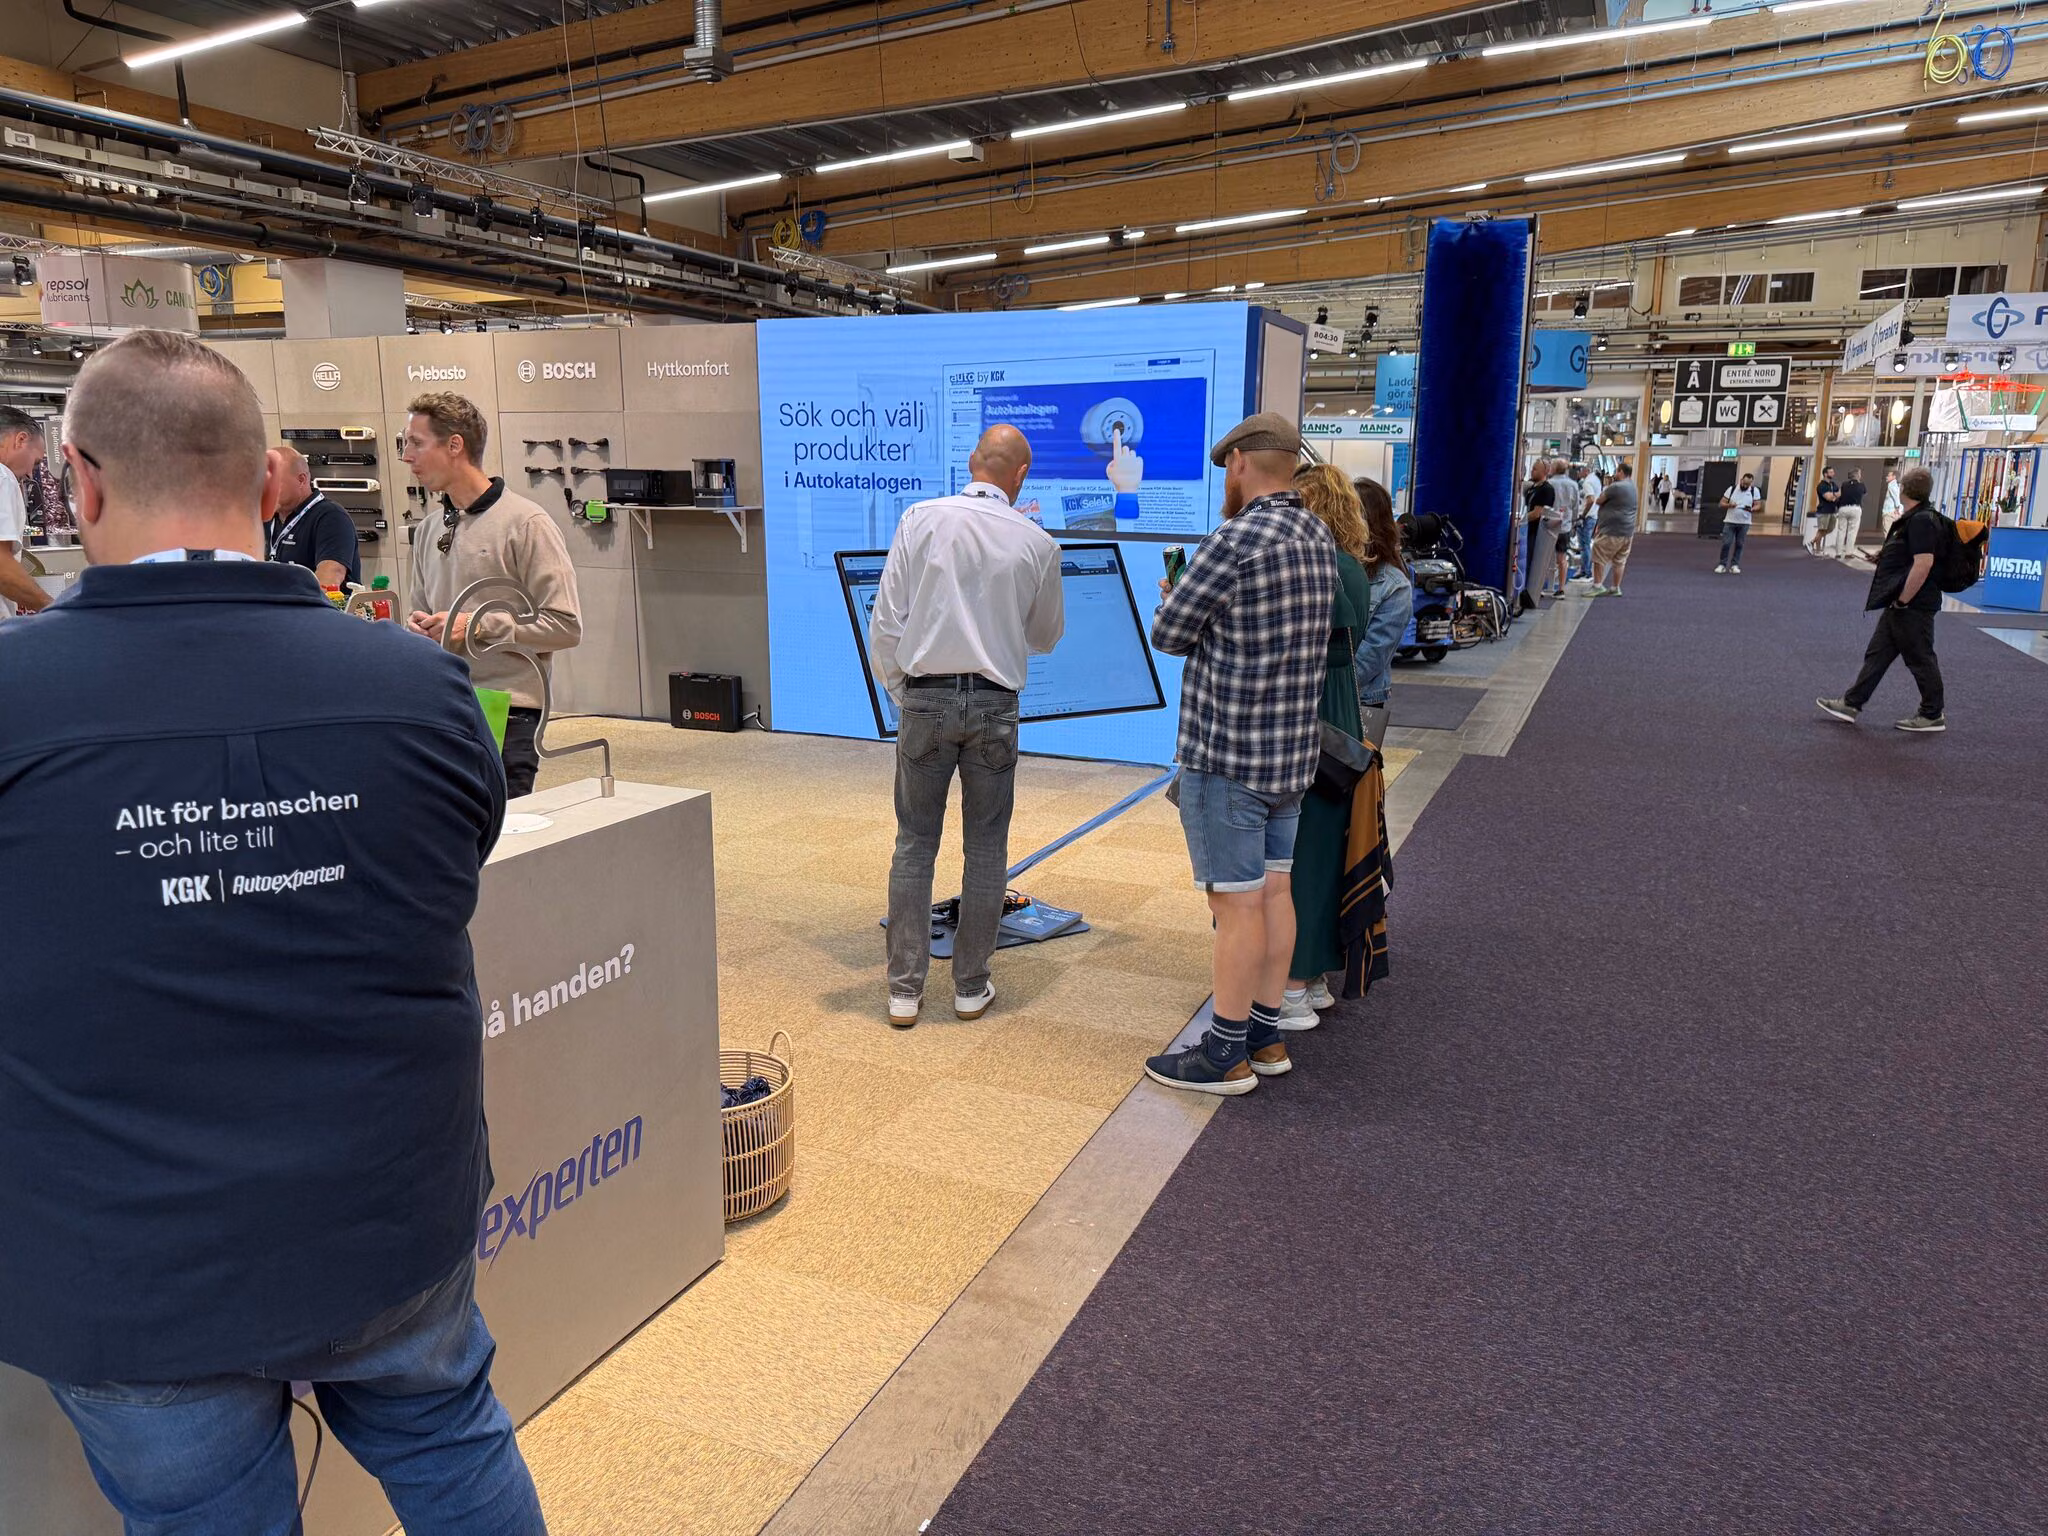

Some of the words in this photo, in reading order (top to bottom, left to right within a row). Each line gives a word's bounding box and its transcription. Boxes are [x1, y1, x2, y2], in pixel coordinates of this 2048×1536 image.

[46, 278, 88, 292] repsol
[46, 292, 90, 303] lubricants
[315, 371, 341, 381] HELLA
[408, 365, 467, 382] Webasto
[542, 362, 596, 379] BOSCH
[647, 360, 730, 379] Hyttkomfort
[977, 371, 989, 384] by
[991, 370, 1005, 381] KGK
[1727, 368, 1752, 378] ENTRÉ
[1754, 369, 1776, 377] NORD
[1687, 371, 1700, 388] A
[779, 401, 823, 427] Sök
[831, 401, 875, 427] och
[885, 401, 924, 433] välj
[1720, 406, 1737, 417] WC
[794, 435, 911, 466] produkter
[784, 471, 789, 488] i
[794, 472, 922, 494] Autokatalogen
[1991, 557, 2042, 575] WISTRA
[694, 712, 720, 721] BOSCH
[115, 805, 167, 831] Allt
[171, 802, 213, 824] för
[221, 791, 359, 820] branschen
[140, 833, 192, 859] och
[200, 830, 239, 852] lite
[245, 826, 274, 848] till
[161, 875, 212, 906] KGK
[232, 864, 345, 895] Autoexperten
[512, 943, 635, 1027] handen?
[477, 1115, 643, 1275] experten
